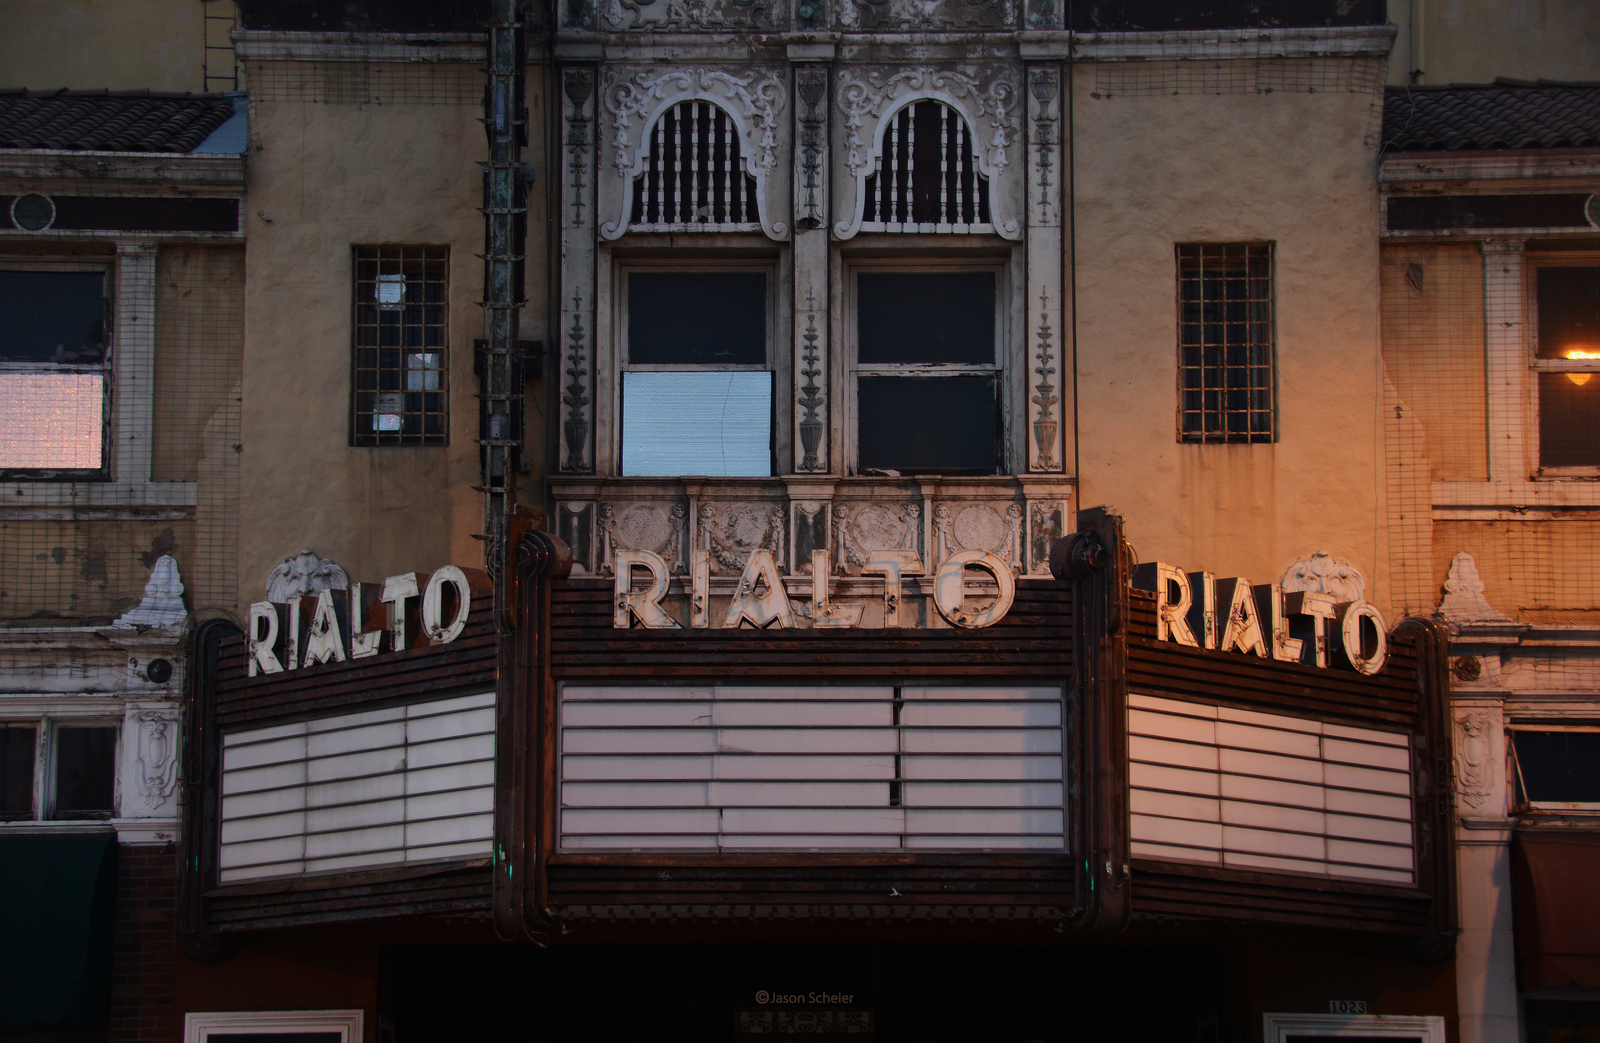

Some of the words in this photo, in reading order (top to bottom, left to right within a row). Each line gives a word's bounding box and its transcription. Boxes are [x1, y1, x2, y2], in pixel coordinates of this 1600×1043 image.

[247, 564, 471, 677] RIALTO
[613, 549, 1016, 629] RIALTO
[1156, 562, 1389, 675] RIALTO
[1331, 1001, 1366, 1013] 1023
